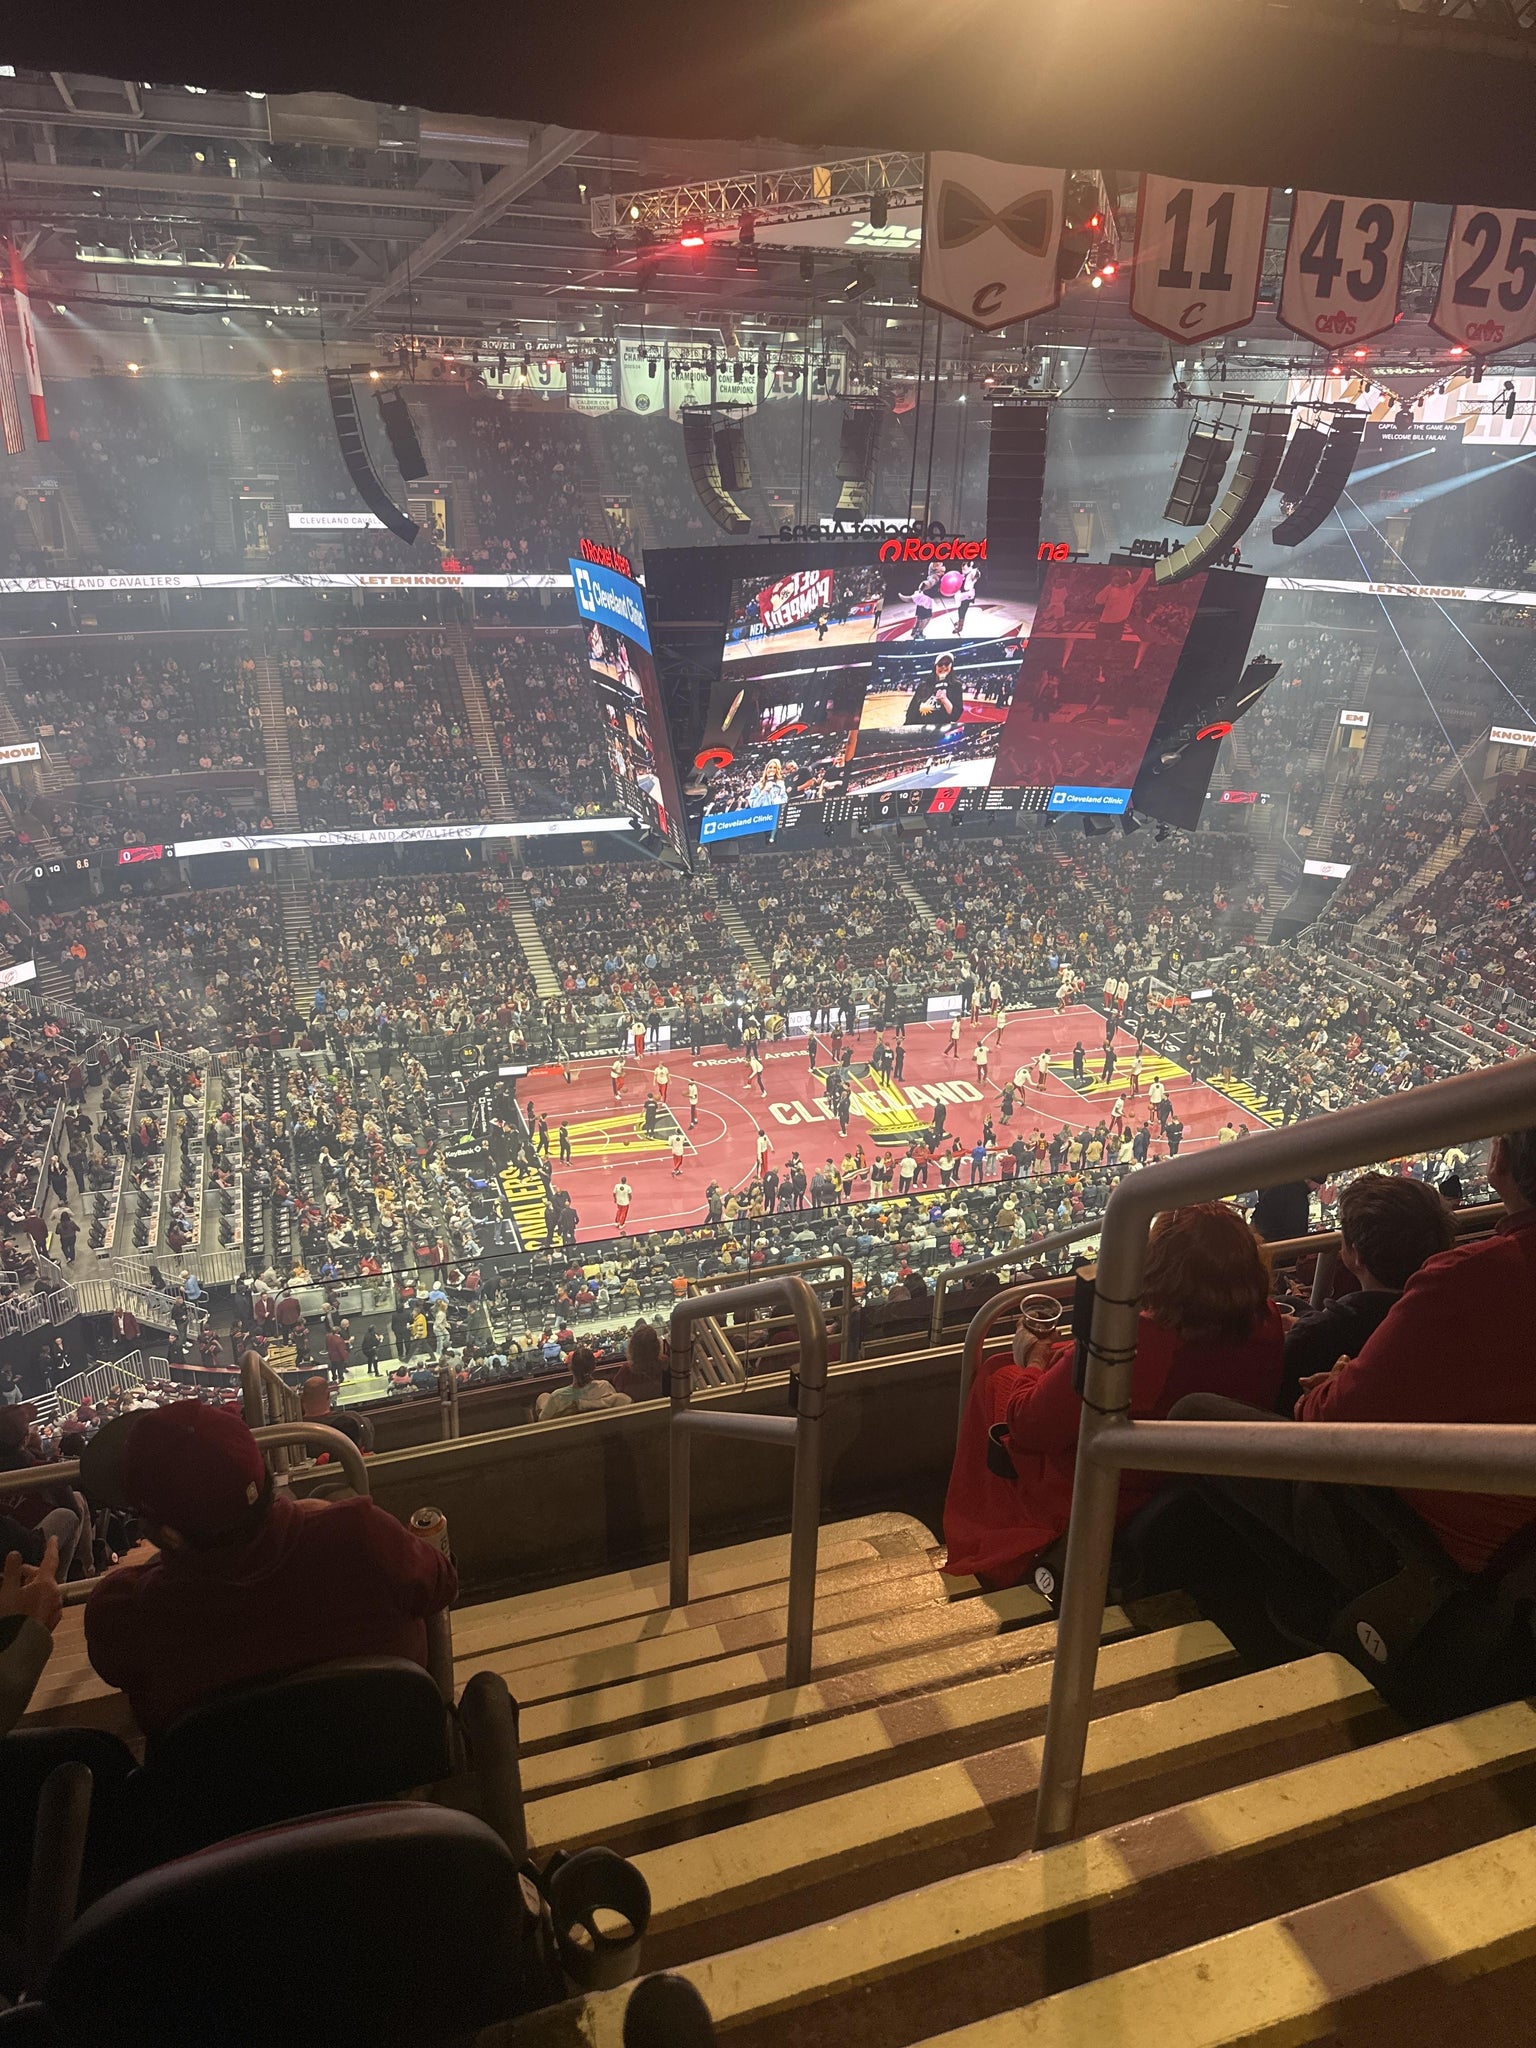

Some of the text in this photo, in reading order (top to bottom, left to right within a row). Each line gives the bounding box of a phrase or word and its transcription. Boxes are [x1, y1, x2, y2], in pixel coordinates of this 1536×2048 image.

[1157, 188, 1235, 291] 11
[1300, 199, 1395, 302] 43
[1452, 211, 1536, 312] 25
[1315, 310, 1357, 335] CAVS
[1465, 319, 1505, 343] CAVS
[718, 375, 756, 385] CONFNCE
[719, 385, 754, 394] CHAMPIONS
[299, 516, 349, 524] CLEVELAND
[902, 537, 987, 561] Rocket
[28, 577, 181, 589] CLEVELAND CAVALIERS
[360, 576, 464, 585] LET EM KNOW.
[1368, 584, 1393, 593] LET
[1419, 587, 1467, 598] KNOW.
[592, 580, 628, 619] Cleveland
[1345, 714, 1363, 722] EM
[0, 747, 39, 760] NOW.
[938, 801, 945, 810] 0
[1066, 794, 1124, 805] Cleveland Clinic
[881, 805, 889, 815] 0
[717, 813, 773, 831] Cleveland Clinic
[319, 828, 472, 844] CLEVELAND CAVALIERS
[123, 851, 131, 861] 0
[34, 858, 89, 878] 0 1Q 8.6
[764, 1049, 809, 1060] Arena
[445, 1147, 475, 1158] KeyBank
[1037, 1572, 1051, 1589] 10
[1363, 1630, 1381, 1653] 11
